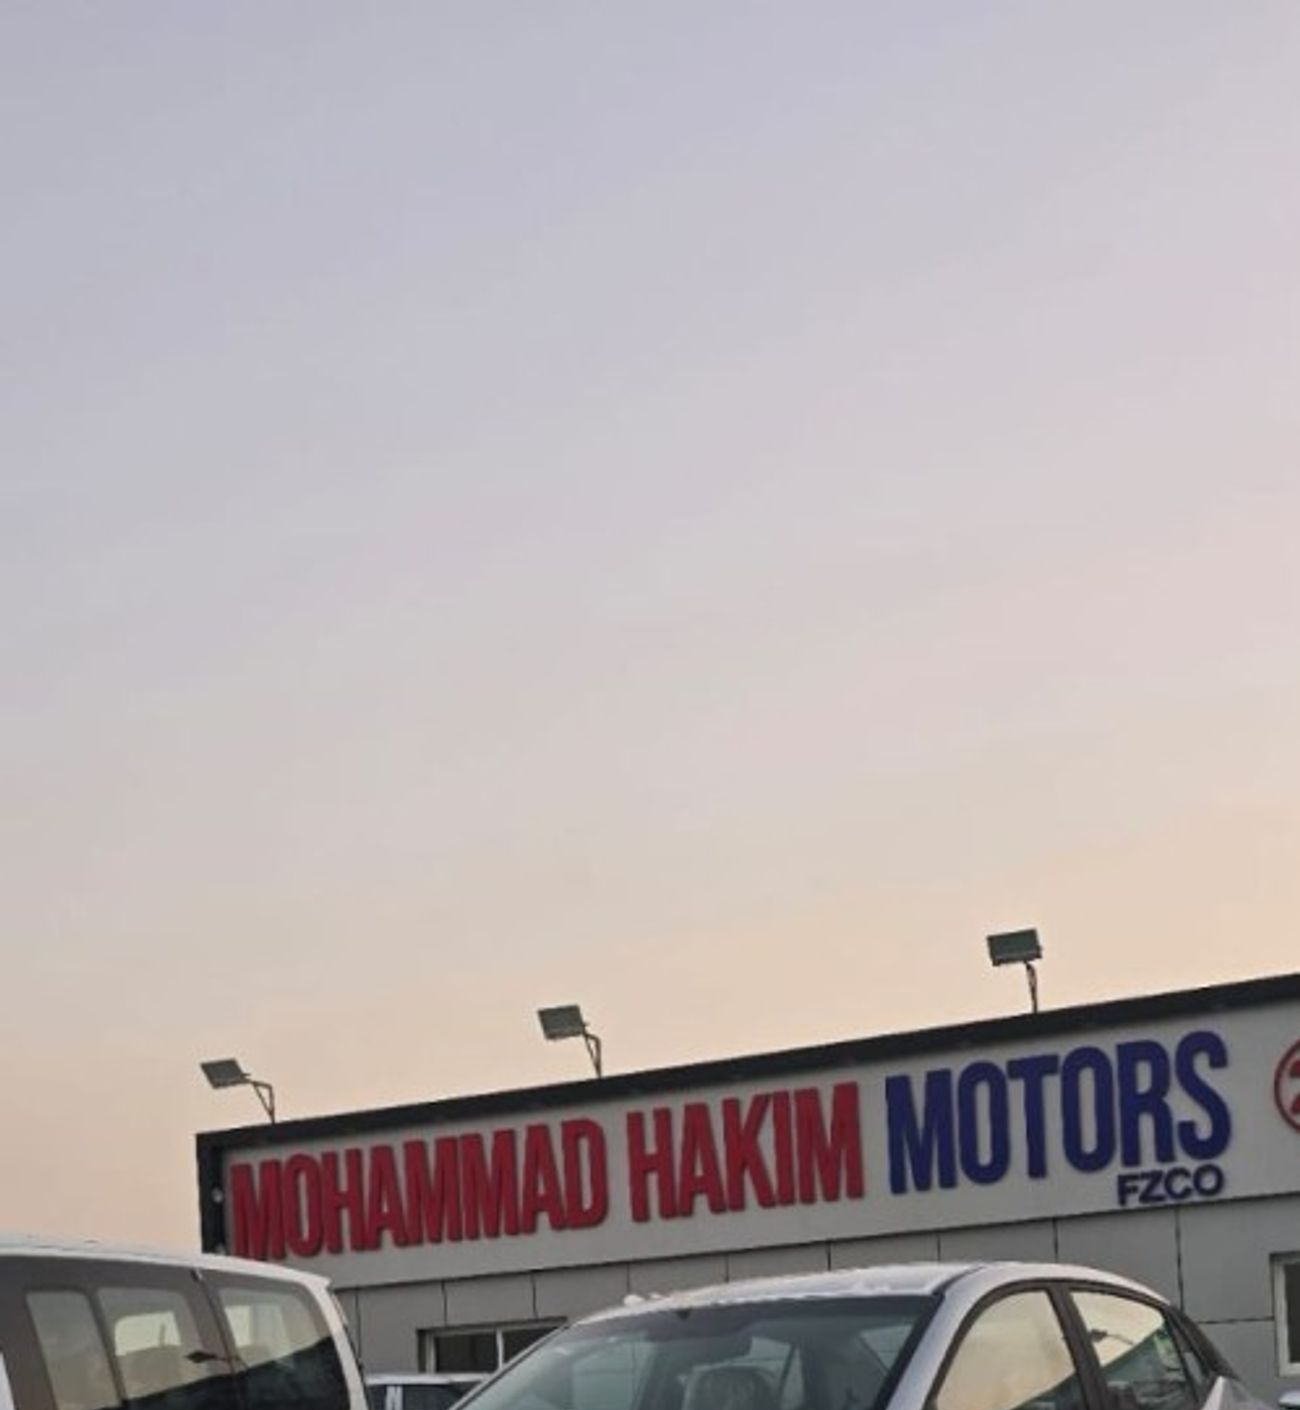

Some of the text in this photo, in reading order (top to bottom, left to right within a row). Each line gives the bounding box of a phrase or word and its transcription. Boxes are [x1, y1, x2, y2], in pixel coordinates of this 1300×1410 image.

[230, 1117, 609, 1261] MOHAMMAD
[625, 1081, 865, 1221] HAKIM
[885, 1030, 1231, 1194] MOTORS
[1117, 1164, 1225, 1206] FZCO
